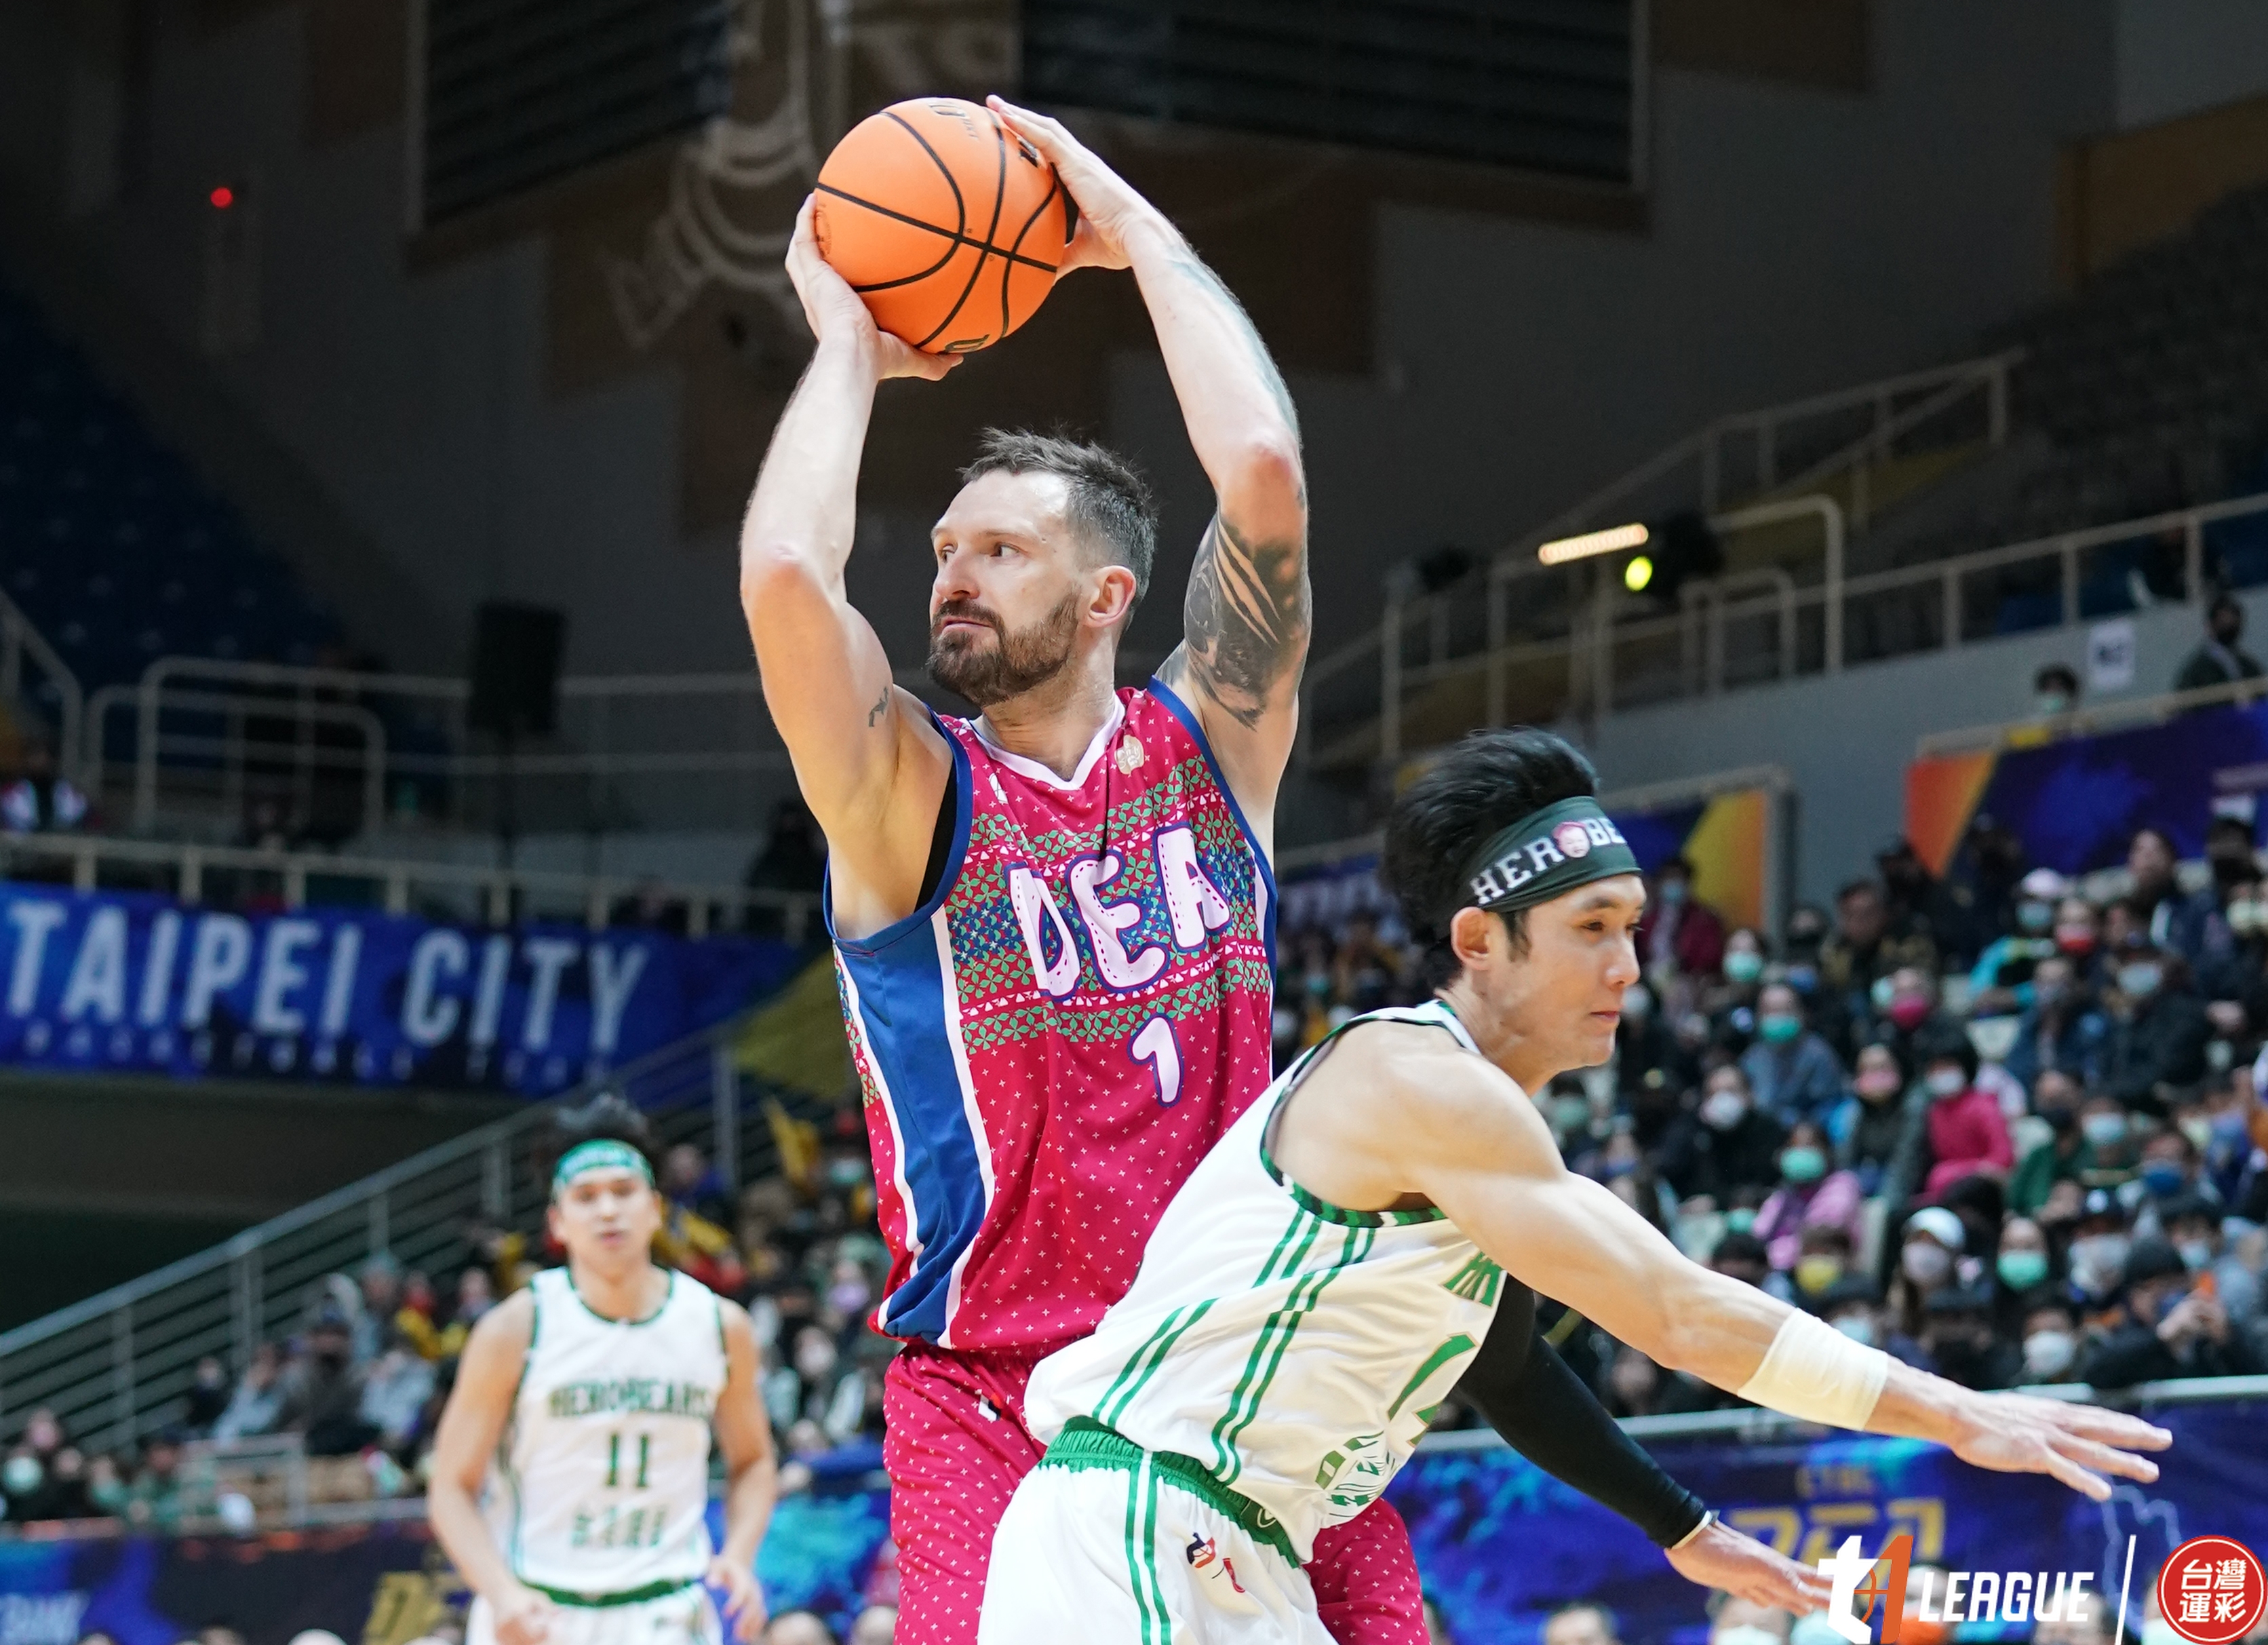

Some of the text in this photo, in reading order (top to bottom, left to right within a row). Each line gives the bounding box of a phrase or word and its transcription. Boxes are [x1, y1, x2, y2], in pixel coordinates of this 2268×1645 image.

[1005, 822, 1232, 1002] DEA
[5, 901, 650, 1052] TAIPEI CITY
[1127, 1012, 1184, 1107] 1
[606, 1432, 652, 1488] 11
